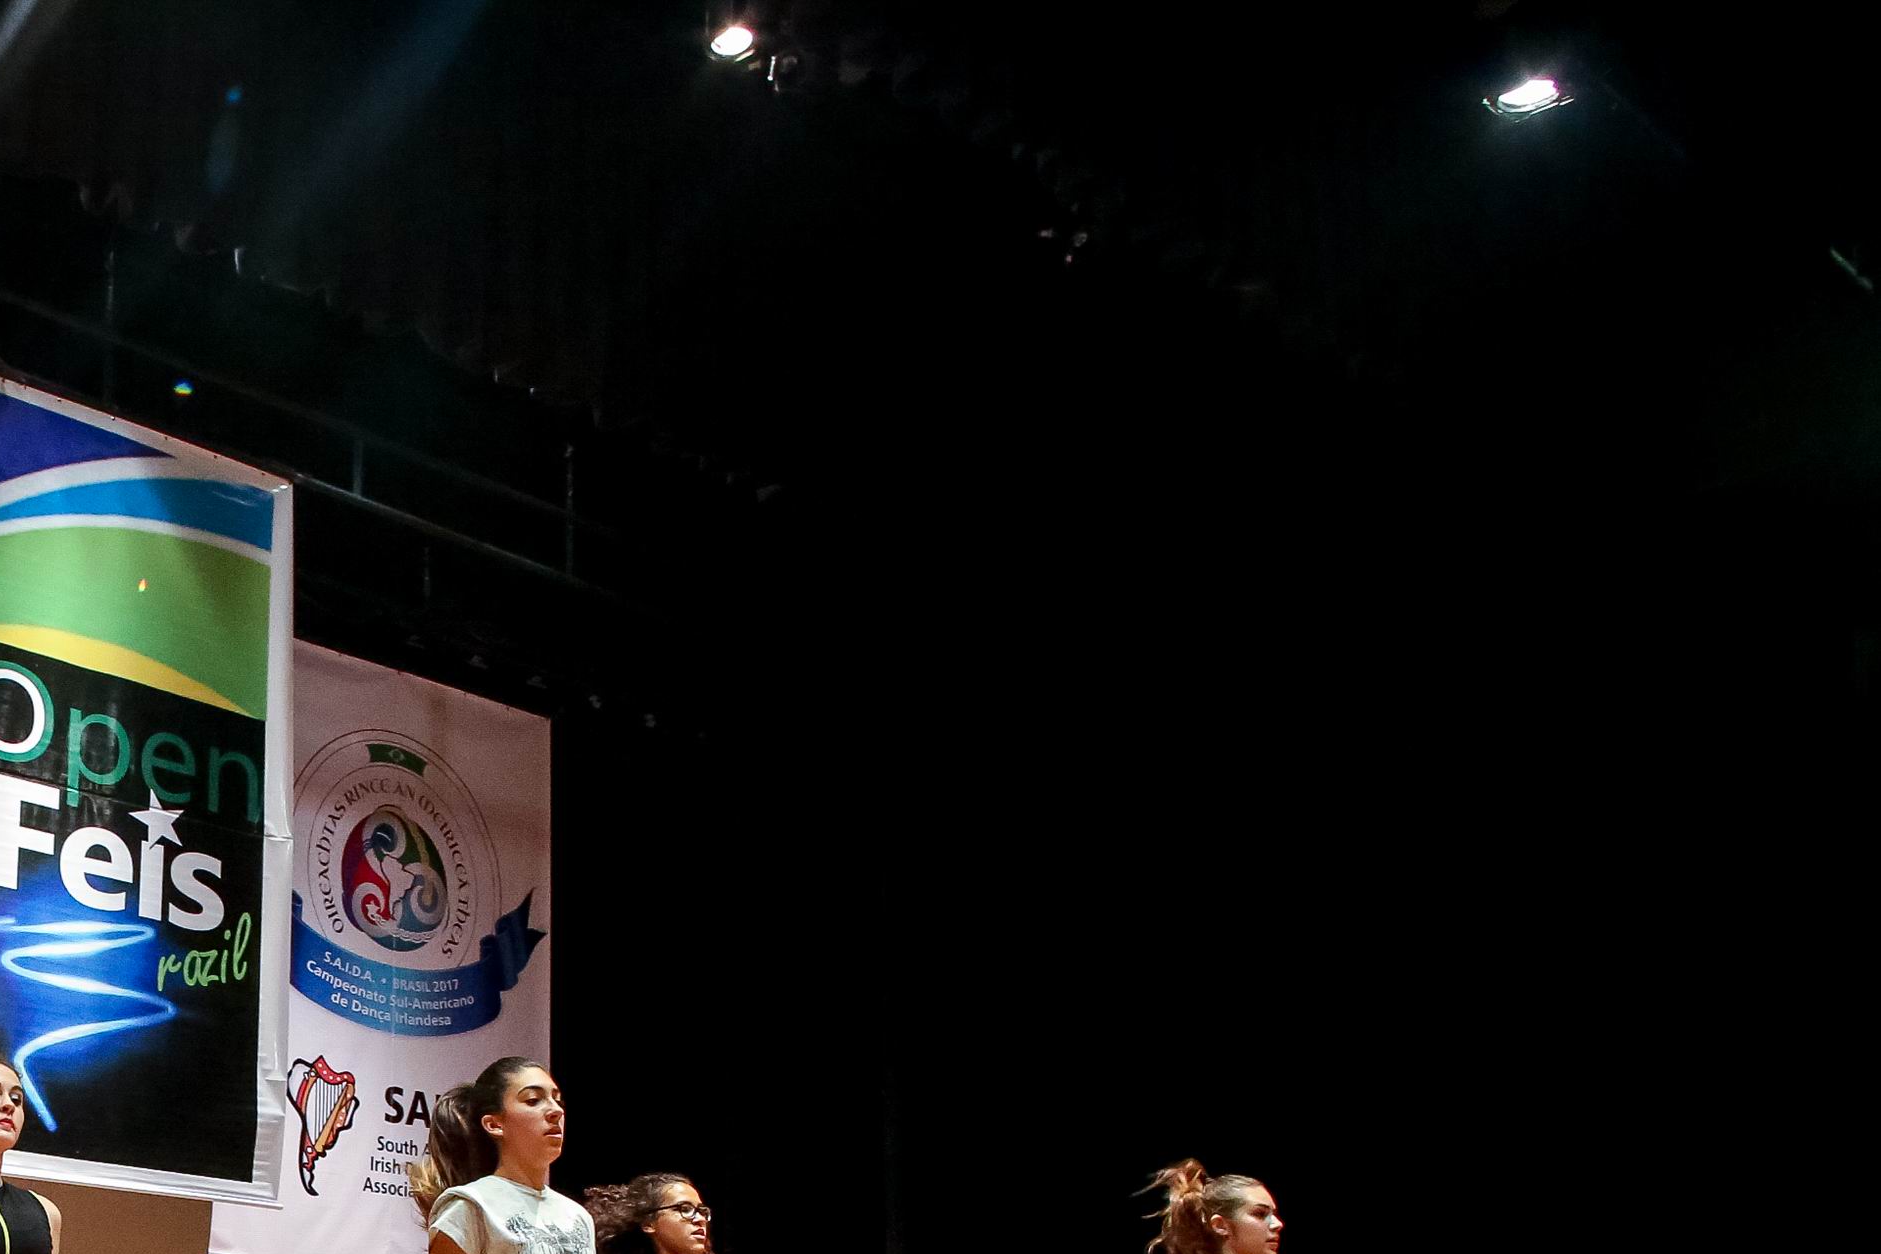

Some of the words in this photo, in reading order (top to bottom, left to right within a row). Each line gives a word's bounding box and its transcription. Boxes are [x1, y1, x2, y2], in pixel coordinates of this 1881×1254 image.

[306, 959, 387, 1005] Campeonato
[389, 994, 475, 1011] Sul-Americano
[392, 978, 431, 993] BRASIL
[433, 978, 460, 993] 2017
[330, 991, 349, 1008] de
[351, 1000, 391, 1023] Dança
[394, 1012, 452, 1027] Irlandesa
[376, 1135, 418, 1156] South
[370, 1155, 401, 1175] Irish
